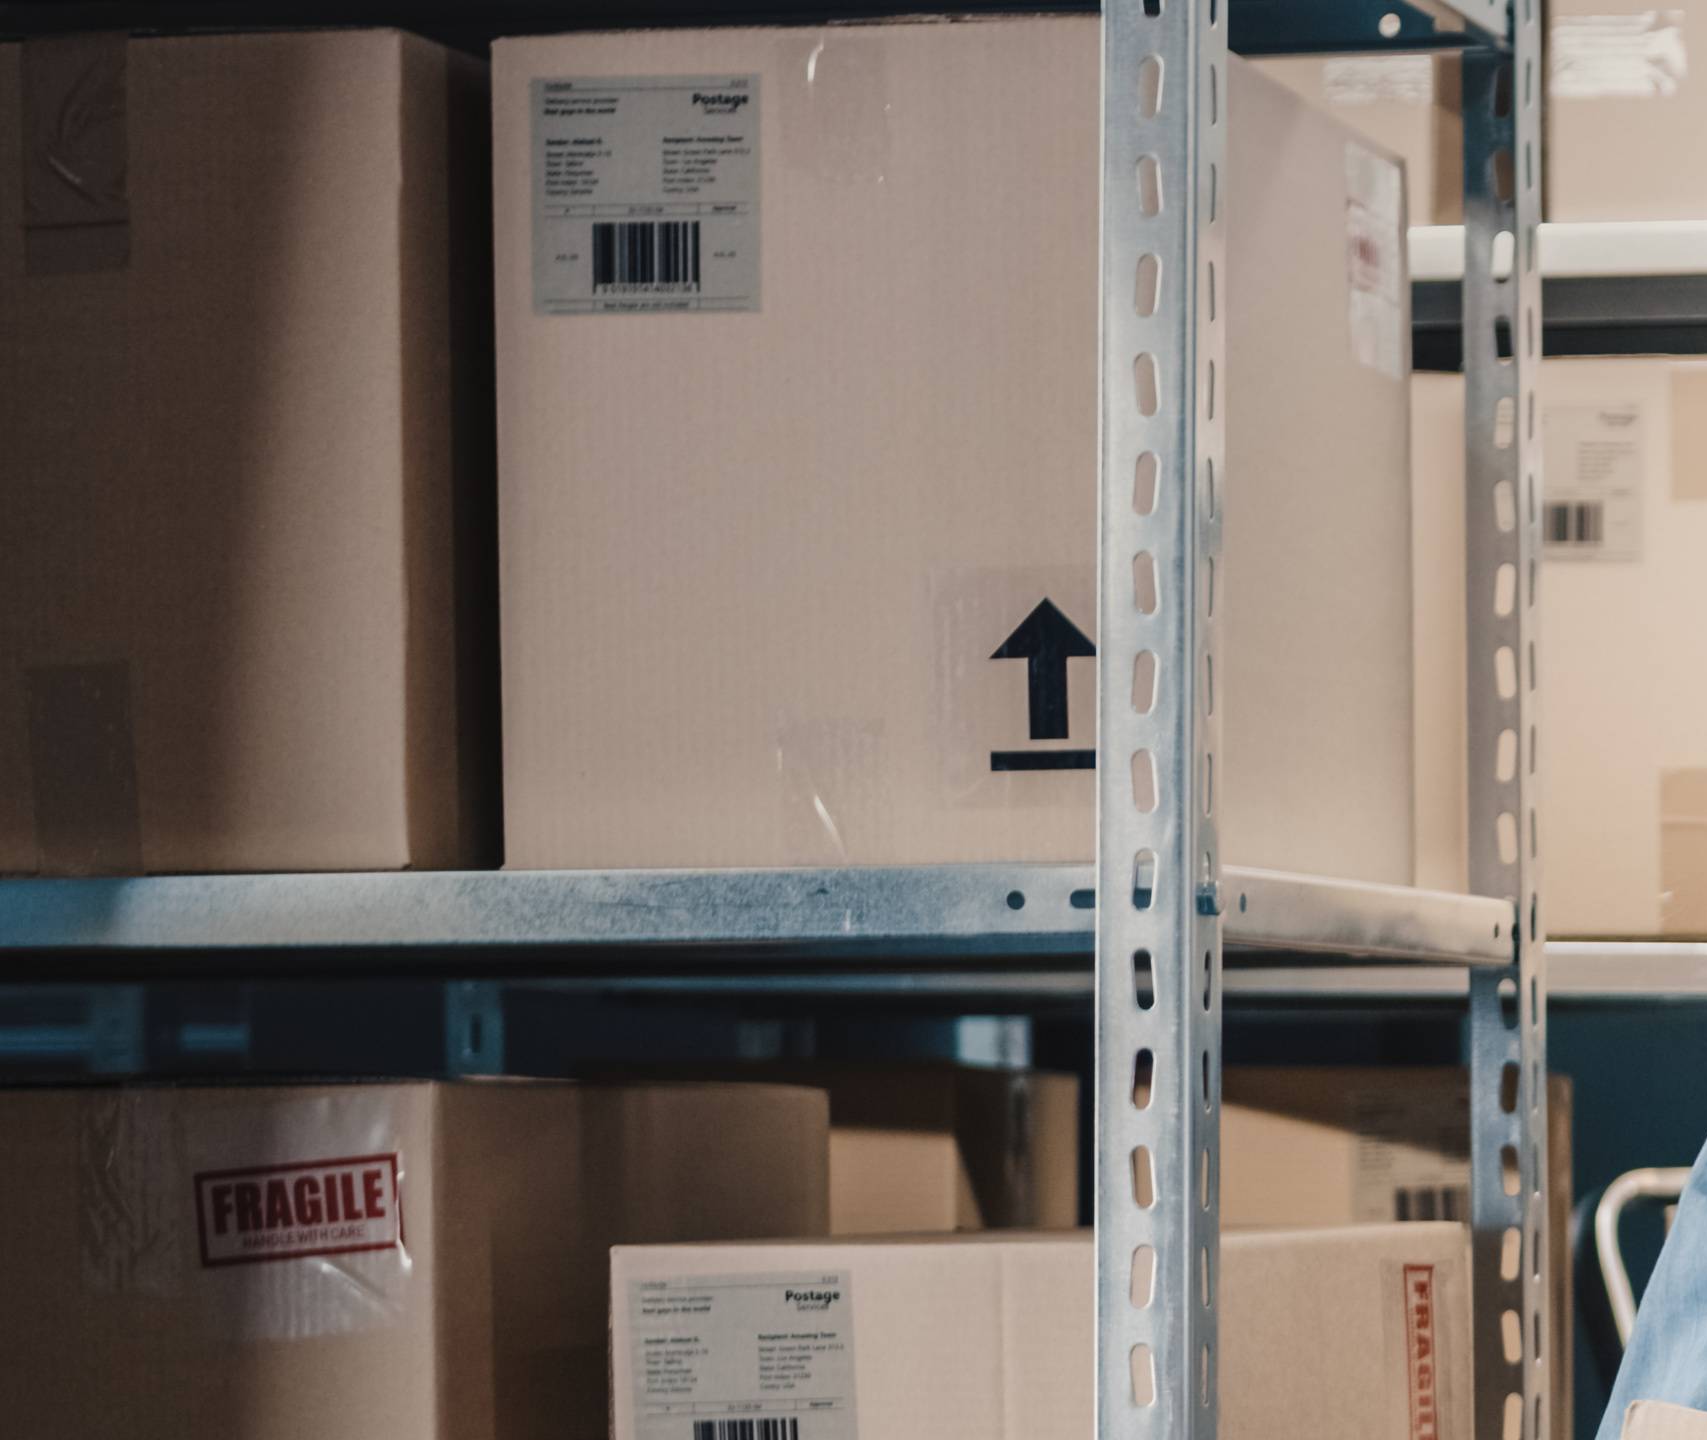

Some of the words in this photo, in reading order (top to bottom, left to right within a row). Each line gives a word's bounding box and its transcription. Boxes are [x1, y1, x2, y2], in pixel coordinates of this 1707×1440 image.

[692, 93, 749, 109] Postage
[211, 1169, 385, 1235] FRAGILE
[242, 1232, 295, 1248] HANDLE
[296, 1228, 328, 1243] WITH
[330, 1224, 365, 1239] CARE
[785, 1289, 840, 1305] Postage
